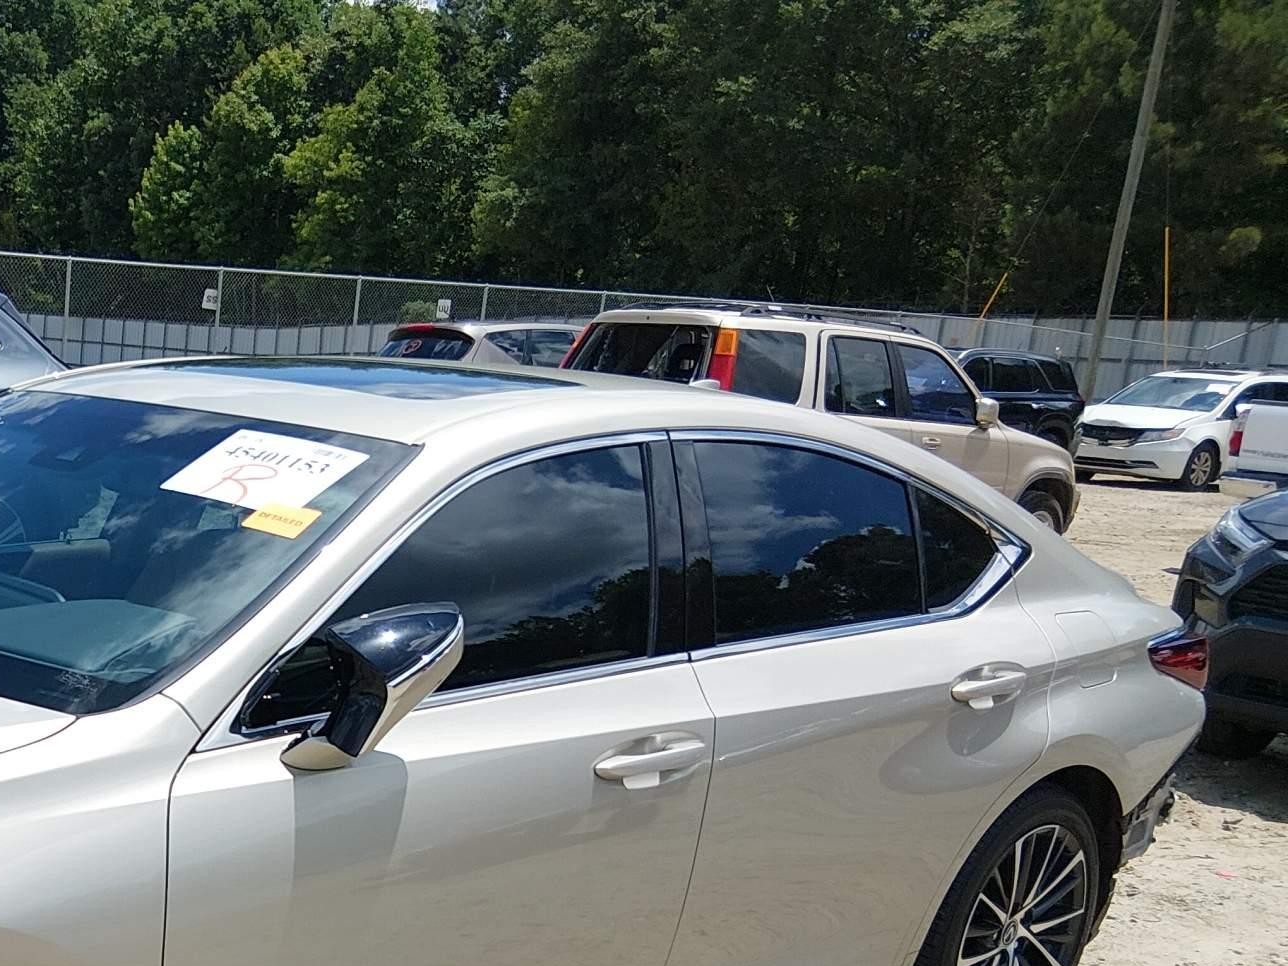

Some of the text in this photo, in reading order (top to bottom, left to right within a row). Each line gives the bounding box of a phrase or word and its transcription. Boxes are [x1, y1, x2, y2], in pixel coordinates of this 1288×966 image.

[206, 294, 218, 304] SS
[225, 446, 331, 475] 45401153
[199, 463, 278, 505] R
[258, 511, 304, 528] DETAILED
